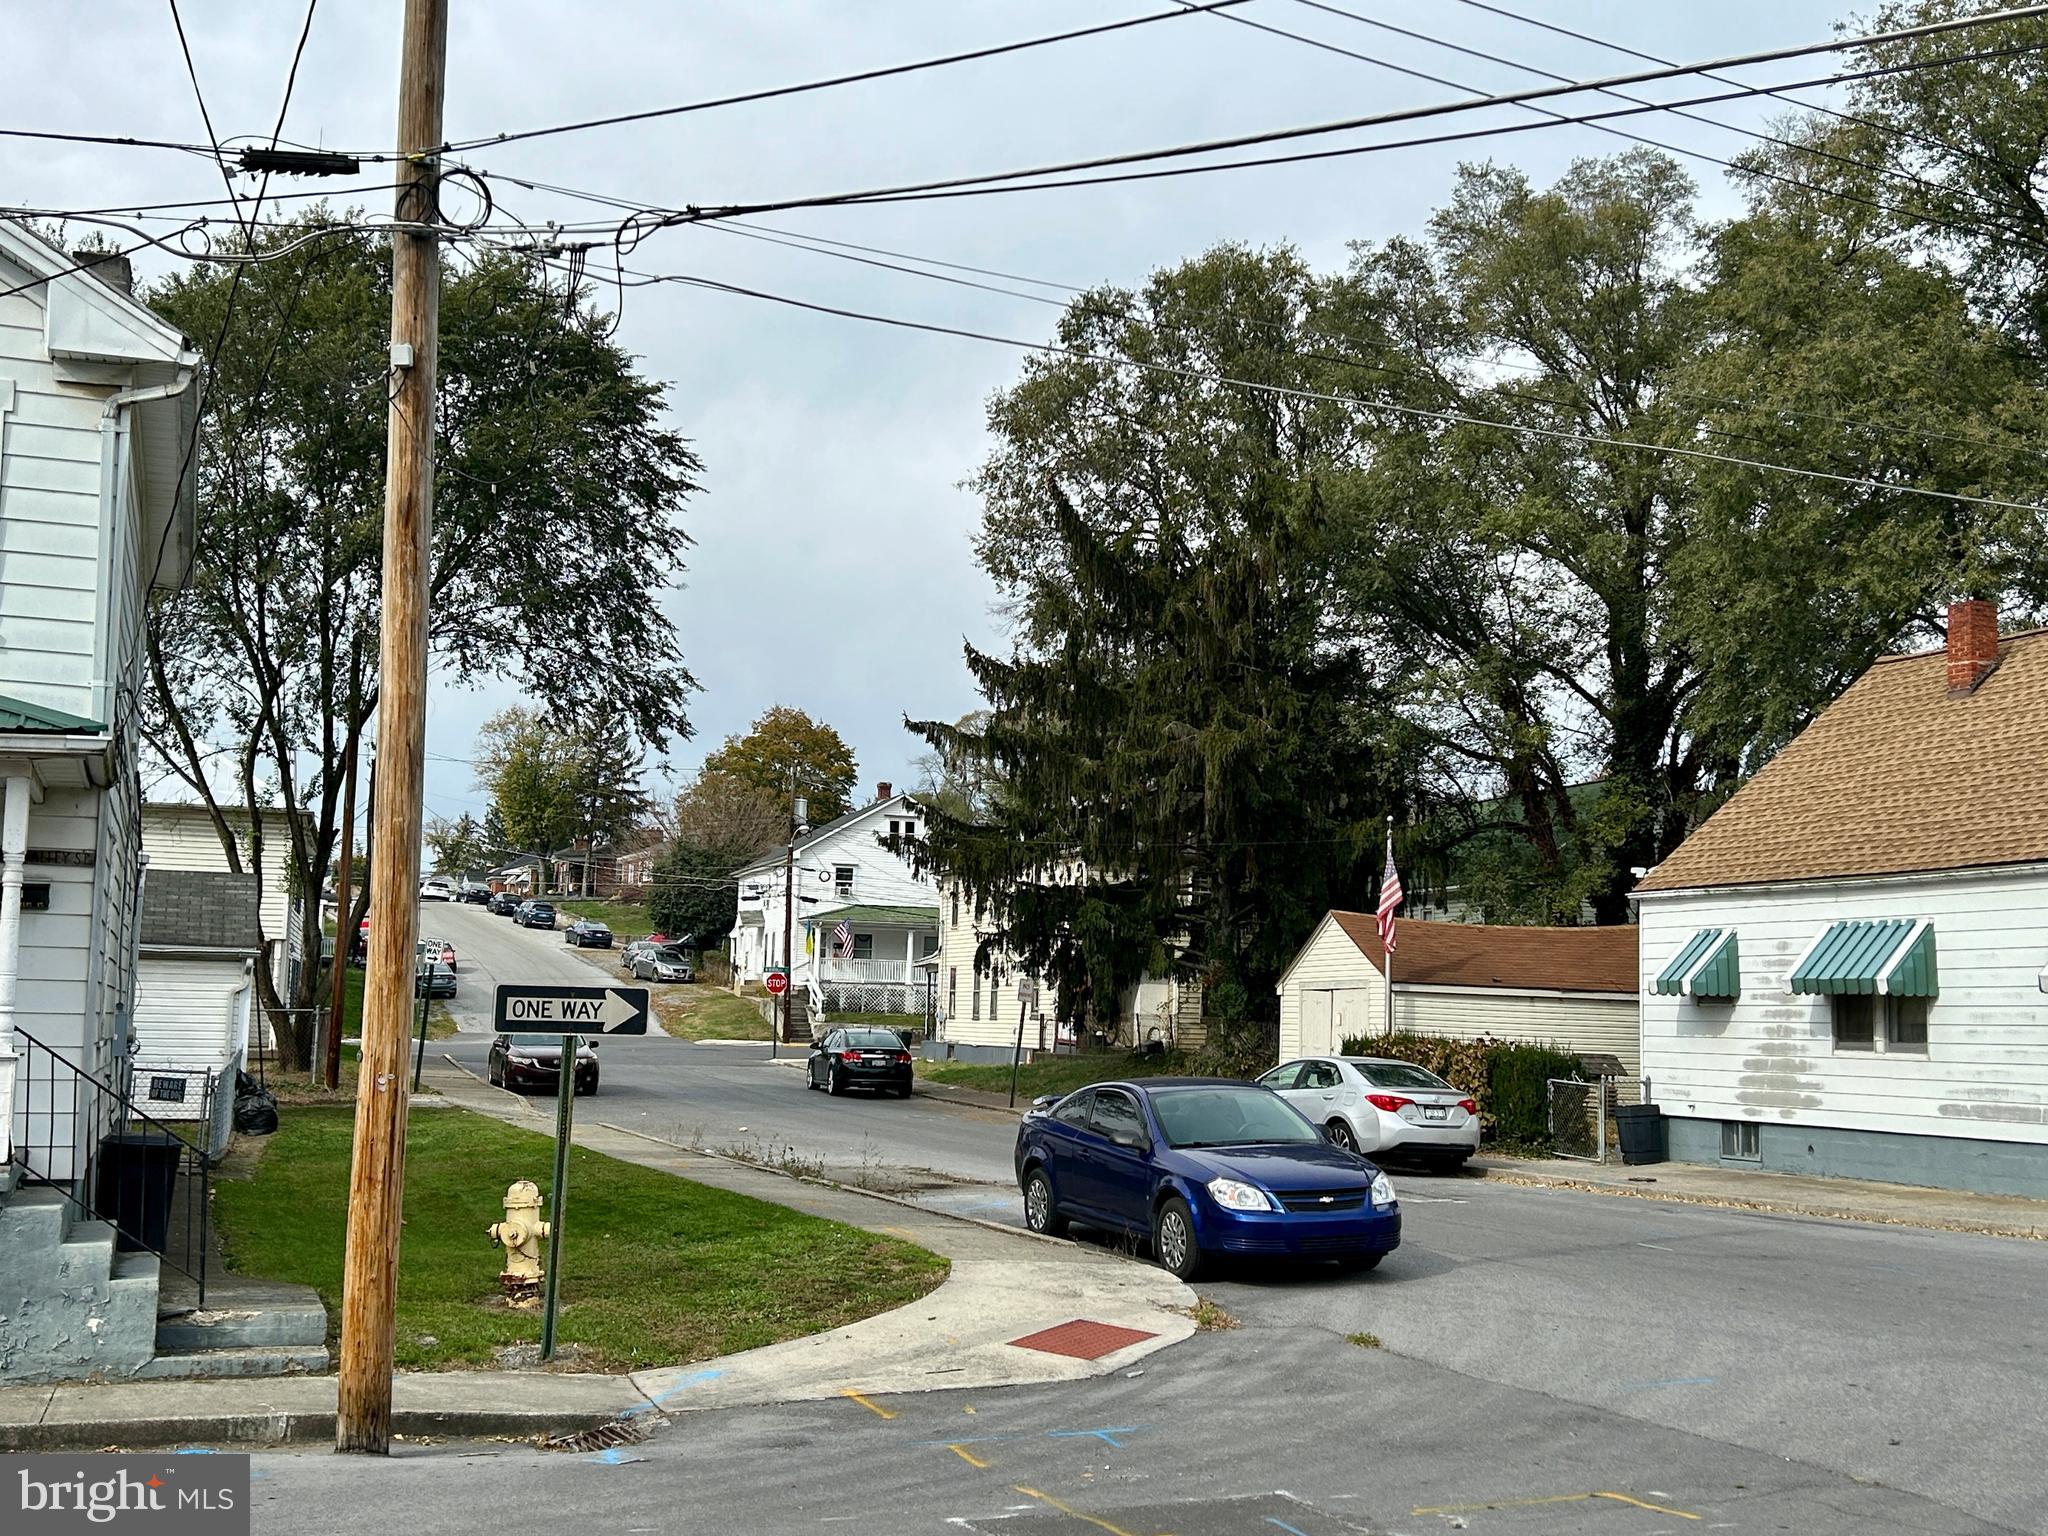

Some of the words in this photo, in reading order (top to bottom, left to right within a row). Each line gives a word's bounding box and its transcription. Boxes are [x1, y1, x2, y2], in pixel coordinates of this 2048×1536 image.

[427, 940, 442, 948] ONE
[427, 947, 441, 955] WAY
[767, 978, 786, 988] STOP
[512, 999, 553, 1019] ONE
[561, 1000, 604, 1020] WAY
[153, 1078, 183, 1090] BEWARE
[151, 1088, 160, 1098] OF
[159, 1089, 170, 1099] THE
[170, 1089, 184, 1102] DOG
